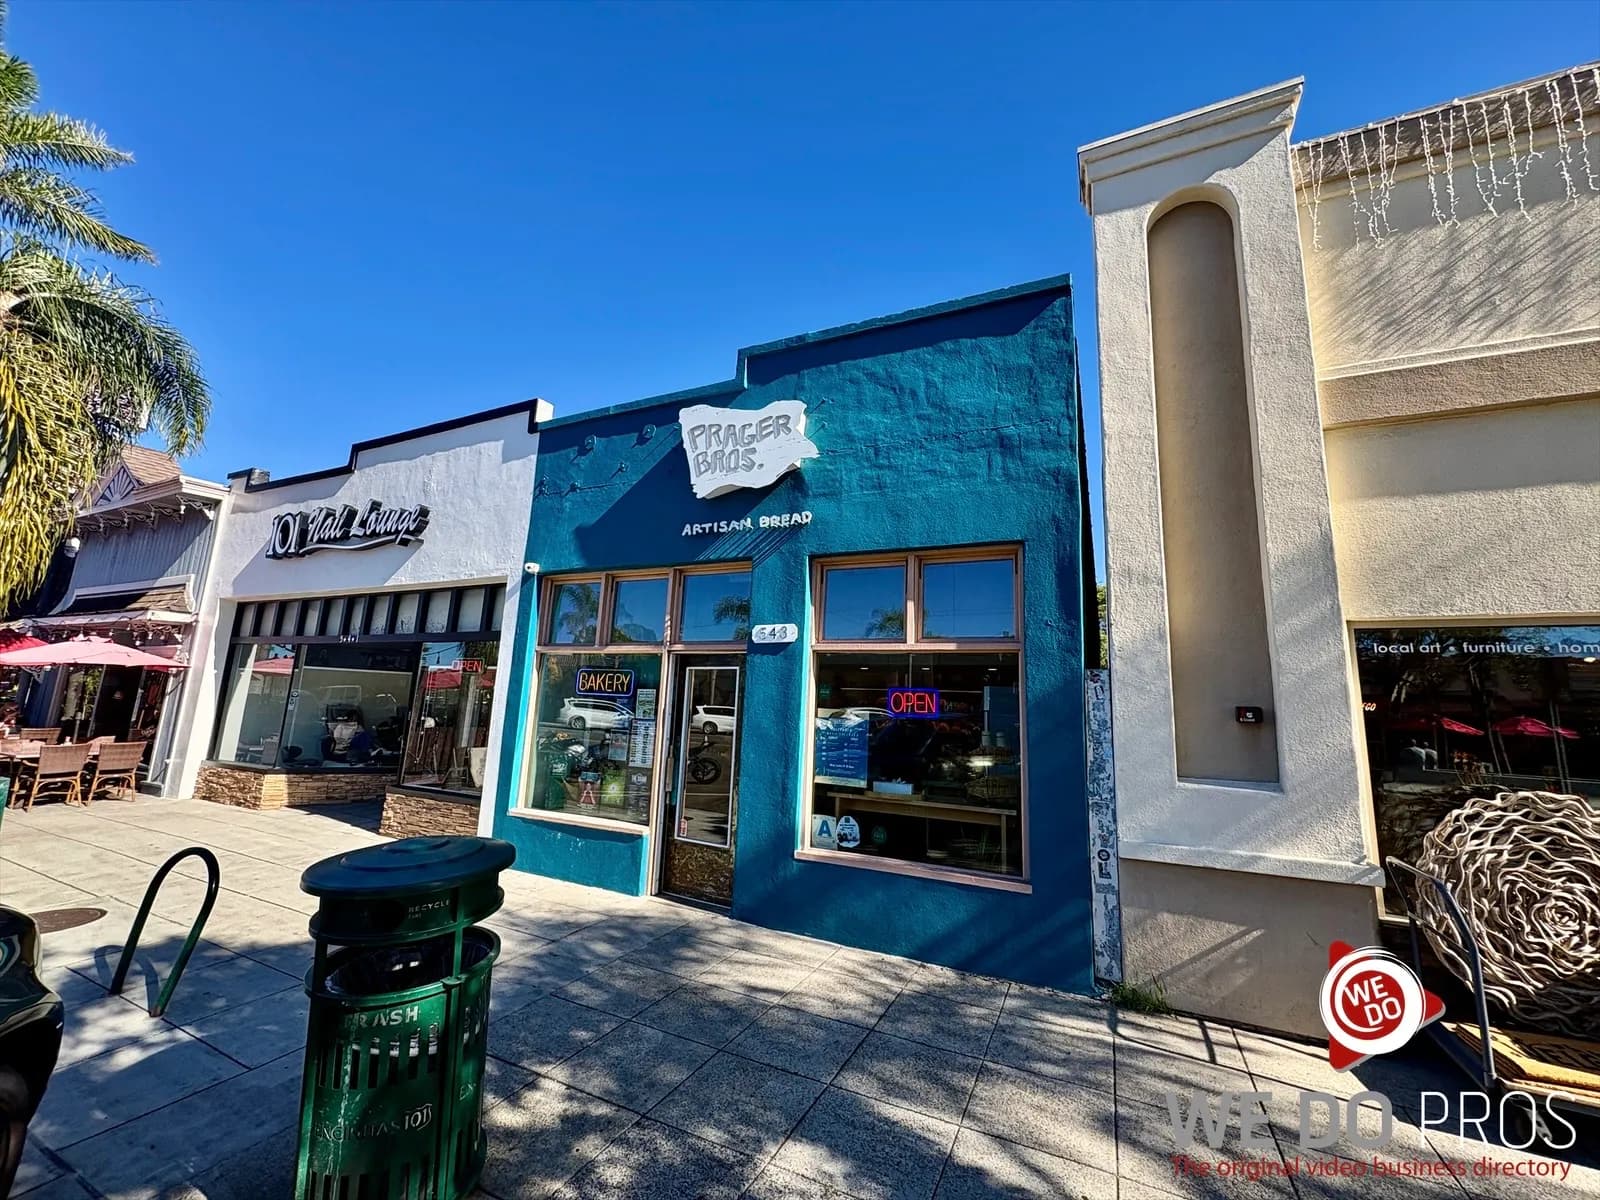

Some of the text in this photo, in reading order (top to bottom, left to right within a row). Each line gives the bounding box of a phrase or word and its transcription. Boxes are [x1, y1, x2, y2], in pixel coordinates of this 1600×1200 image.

[687, 414, 792, 452] PRAGER
[693, 447, 764, 478] BROS.
[266, 499, 429, 554] 101 Nail Lounge
[682, 511, 812, 536] ARTISAN BREAD
[1373, 642, 1414, 654] local
[1419, 642, 1441, 654] art
[1463, 642, 1535, 654] furniture
[452, 660, 481, 672] OPEN
[579, 672, 631, 692] BAKERY
[890, 692, 936, 713] OPEN
[818, 820, 832, 837] A
